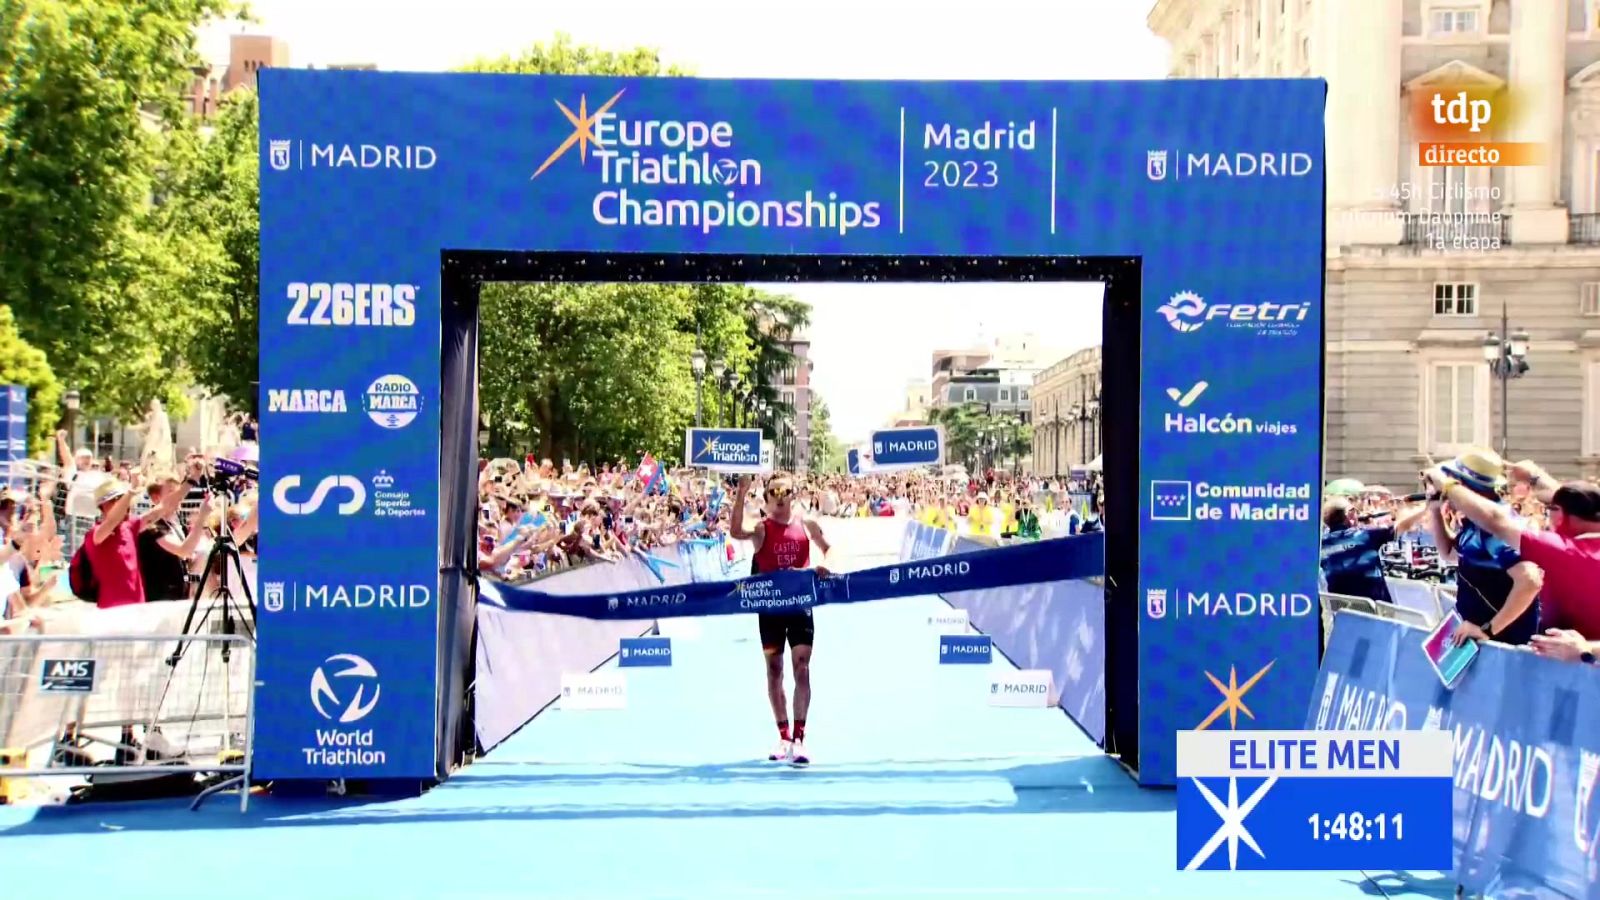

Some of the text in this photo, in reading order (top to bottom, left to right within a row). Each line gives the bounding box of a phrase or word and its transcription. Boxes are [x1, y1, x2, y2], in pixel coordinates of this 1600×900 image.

[595, 113, 733, 151] Europe
[923, 121, 1036, 149] Madrid
[311, 143, 437, 169] MADRID
[1187, 153, 1312, 176] MADRID
[592, 151, 761, 185] Triathlon
[923, 161, 999, 187] 2023
[592, 189, 880, 235] Championships
[287, 282, 415, 326] 226ERS
[375, 383, 411, 392] RADIO
[268, 389, 347, 412] MARCA
[369, 395, 417, 409] MARCA
[1165, 413, 1297, 435] Halcón viajes
[712, 441, 750, 453] Europe
[889, 440, 937, 452] MADRID
[1195, 482, 1310, 498] Comunidad
[1195, 503, 1309, 520] de Madrid
[908, 561, 970, 579] MADRID
[741, 580, 773, 590] Europe
[306, 584, 430, 608] MADRID
[627, 593, 687, 606] MADRID
[1188, 592, 1312, 616] MADRID
[633, 648, 670, 656] MADRID
[952, 645, 989, 654] MADRID
[51, 661, 89, 677] AMS
[1004, 683, 1047, 694] MADRID
[316, 729, 373, 746] World
[302, 748, 385, 765] Triathlon
[1453, 723, 1552, 818] MADRID
